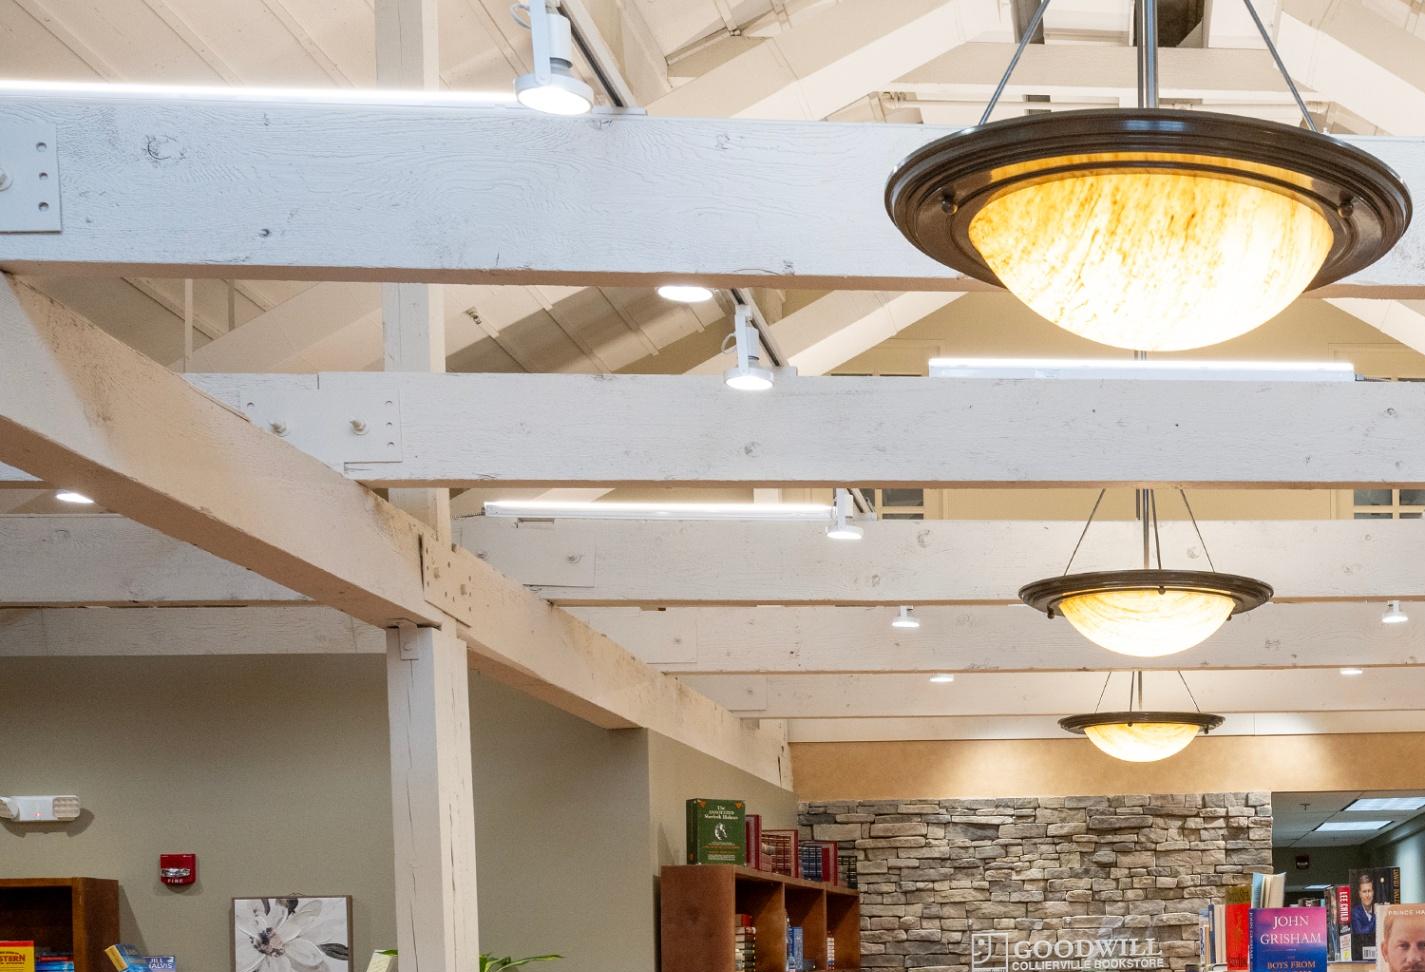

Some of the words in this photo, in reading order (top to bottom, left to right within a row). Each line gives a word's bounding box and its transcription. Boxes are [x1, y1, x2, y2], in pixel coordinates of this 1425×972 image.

[1339, 891, 1348, 903] LEE
[1339, 904, 1349, 922] CHILD
[1273, 916, 1310, 929] JOHN
[1260, 933, 1320, 945] GRISHAM
[1014, 938, 1162, 959] GOODWILL
[1012, 960, 1091, 971] COLLIERVILLE
[1094, 958, 1164, 969] BOOKSTORE
[1267, 961, 1288, 969] BOYS
[1290, 960, 1316, 969] FROM
